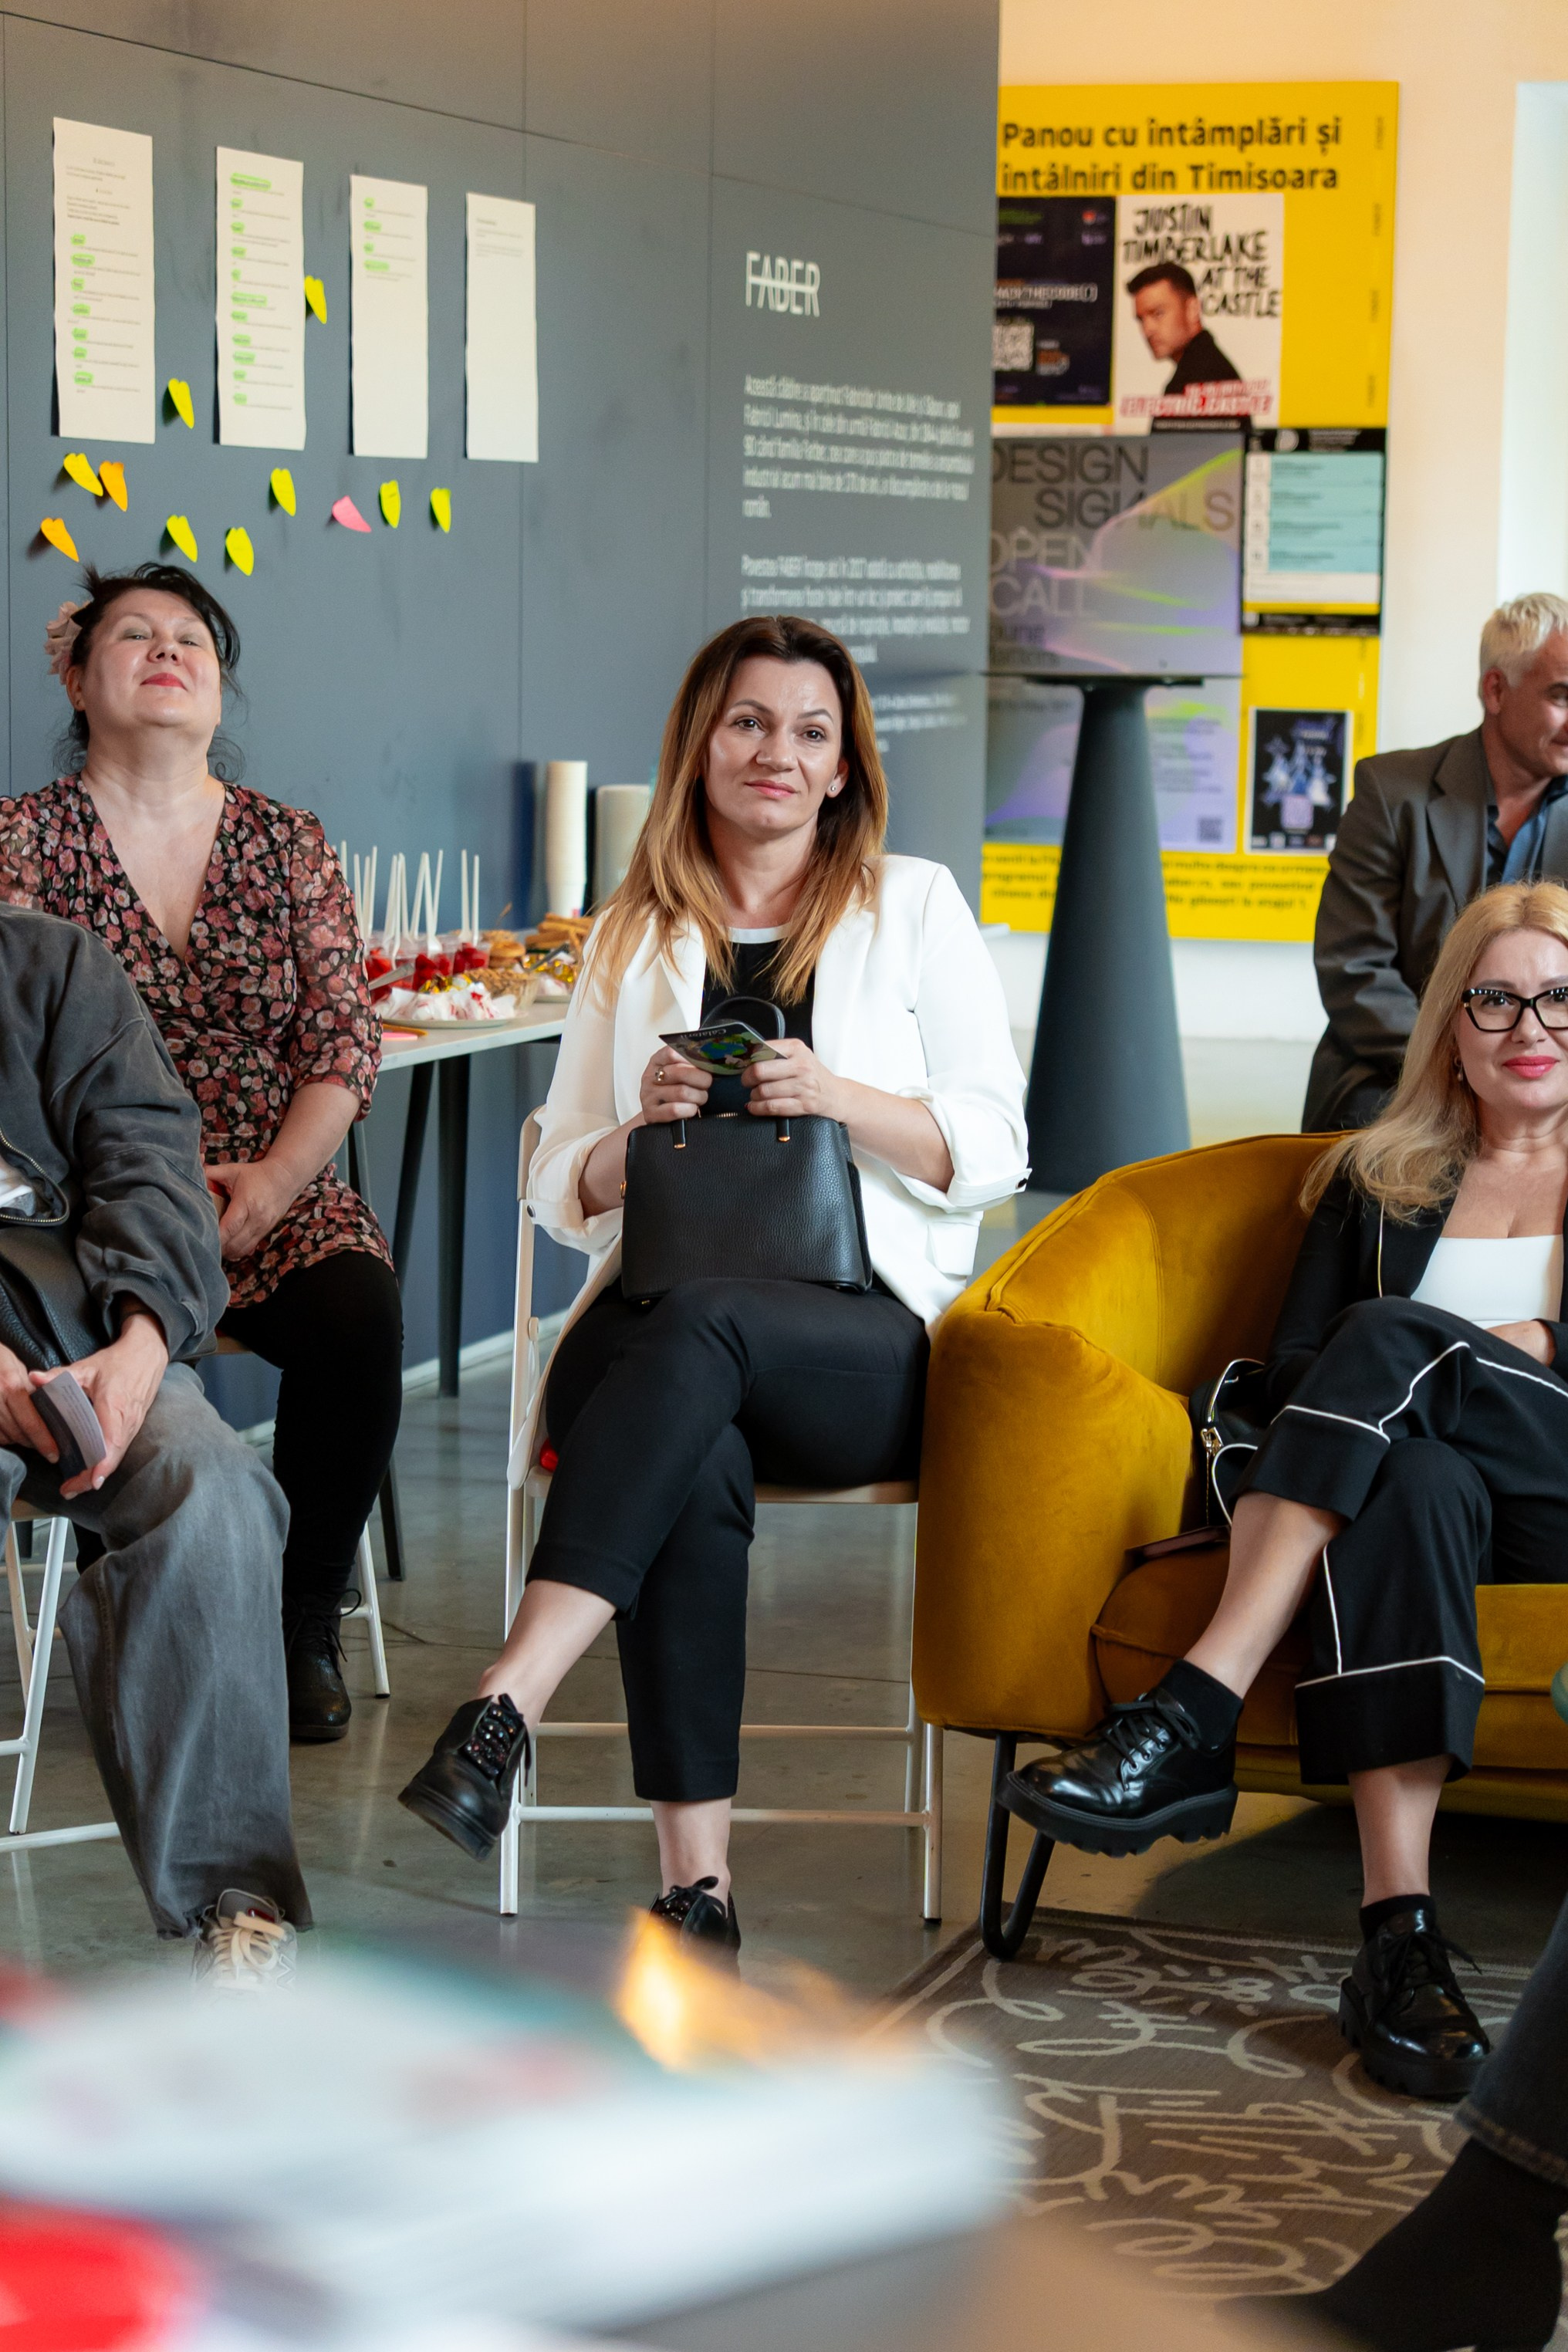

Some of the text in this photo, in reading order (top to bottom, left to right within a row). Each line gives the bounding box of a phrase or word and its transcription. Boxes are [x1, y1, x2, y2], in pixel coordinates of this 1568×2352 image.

[1003, 122, 1093, 148] Panou
[1103, 126, 1137, 147] cu
[1130, 164, 1177, 191] din
[1134, 204, 1211, 235] JUSTIN
[1123, 231, 1268, 264] TIMBERLAKE
[745, 250, 820, 317] FABER
[1201, 266, 1269, 289] AT THE
[1201, 291, 1281, 318] CASTLE
